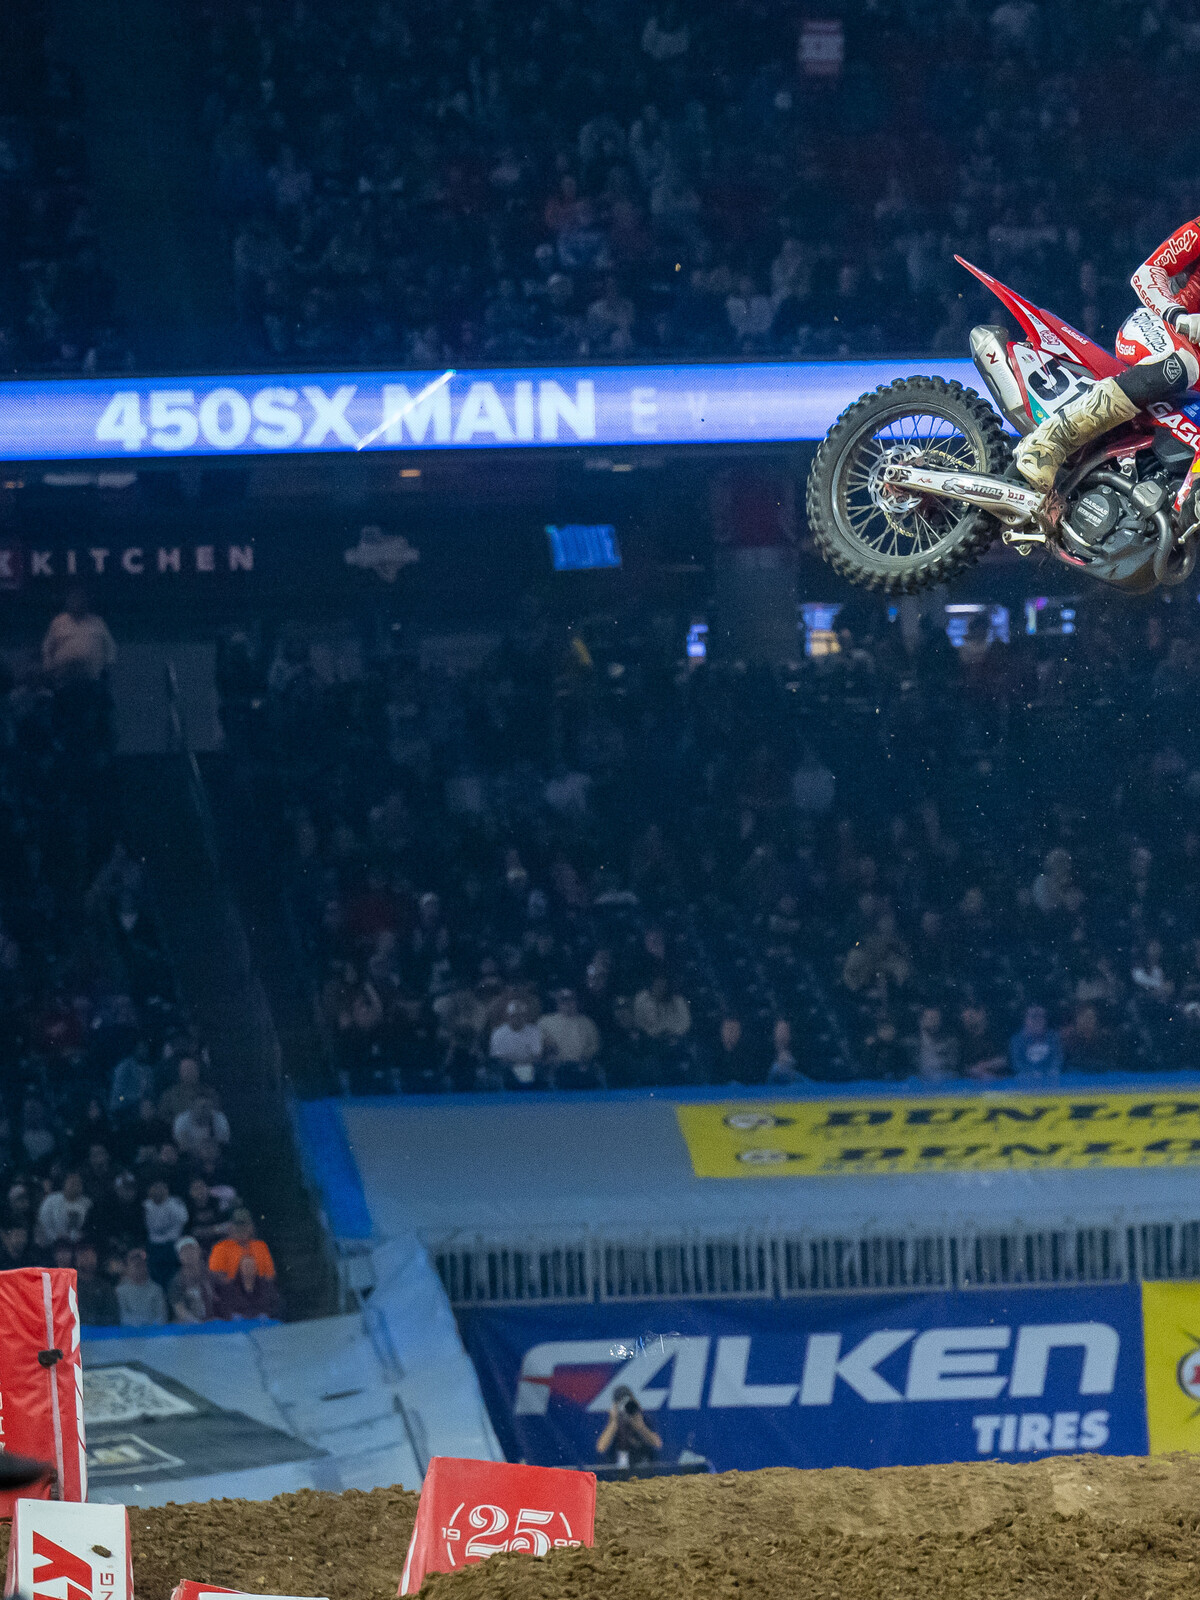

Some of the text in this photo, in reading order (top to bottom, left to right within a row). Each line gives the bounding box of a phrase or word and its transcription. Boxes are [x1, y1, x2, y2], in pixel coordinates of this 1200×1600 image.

[1166, 229, 1199, 256] Troy
[1132, 275, 1162, 316] GASGAS
[1060, 326, 1090, 345] GASGAS
[1116, 340, 1136, 357] ASGAS
[96, 384, 357, 451] 450SX
[382, 379, 596, 446] MAIN
[1082, 497, 1109, 516] GASGAS
[31, 546, 255, 576] KITCHEN
[513, 1322, 1121, 1416] FALKEN
[972, 1409, 1111, 1453] TIRES
[442, 1527, 461, 1541] 19
[465, 1504, 554, 1559] 25
